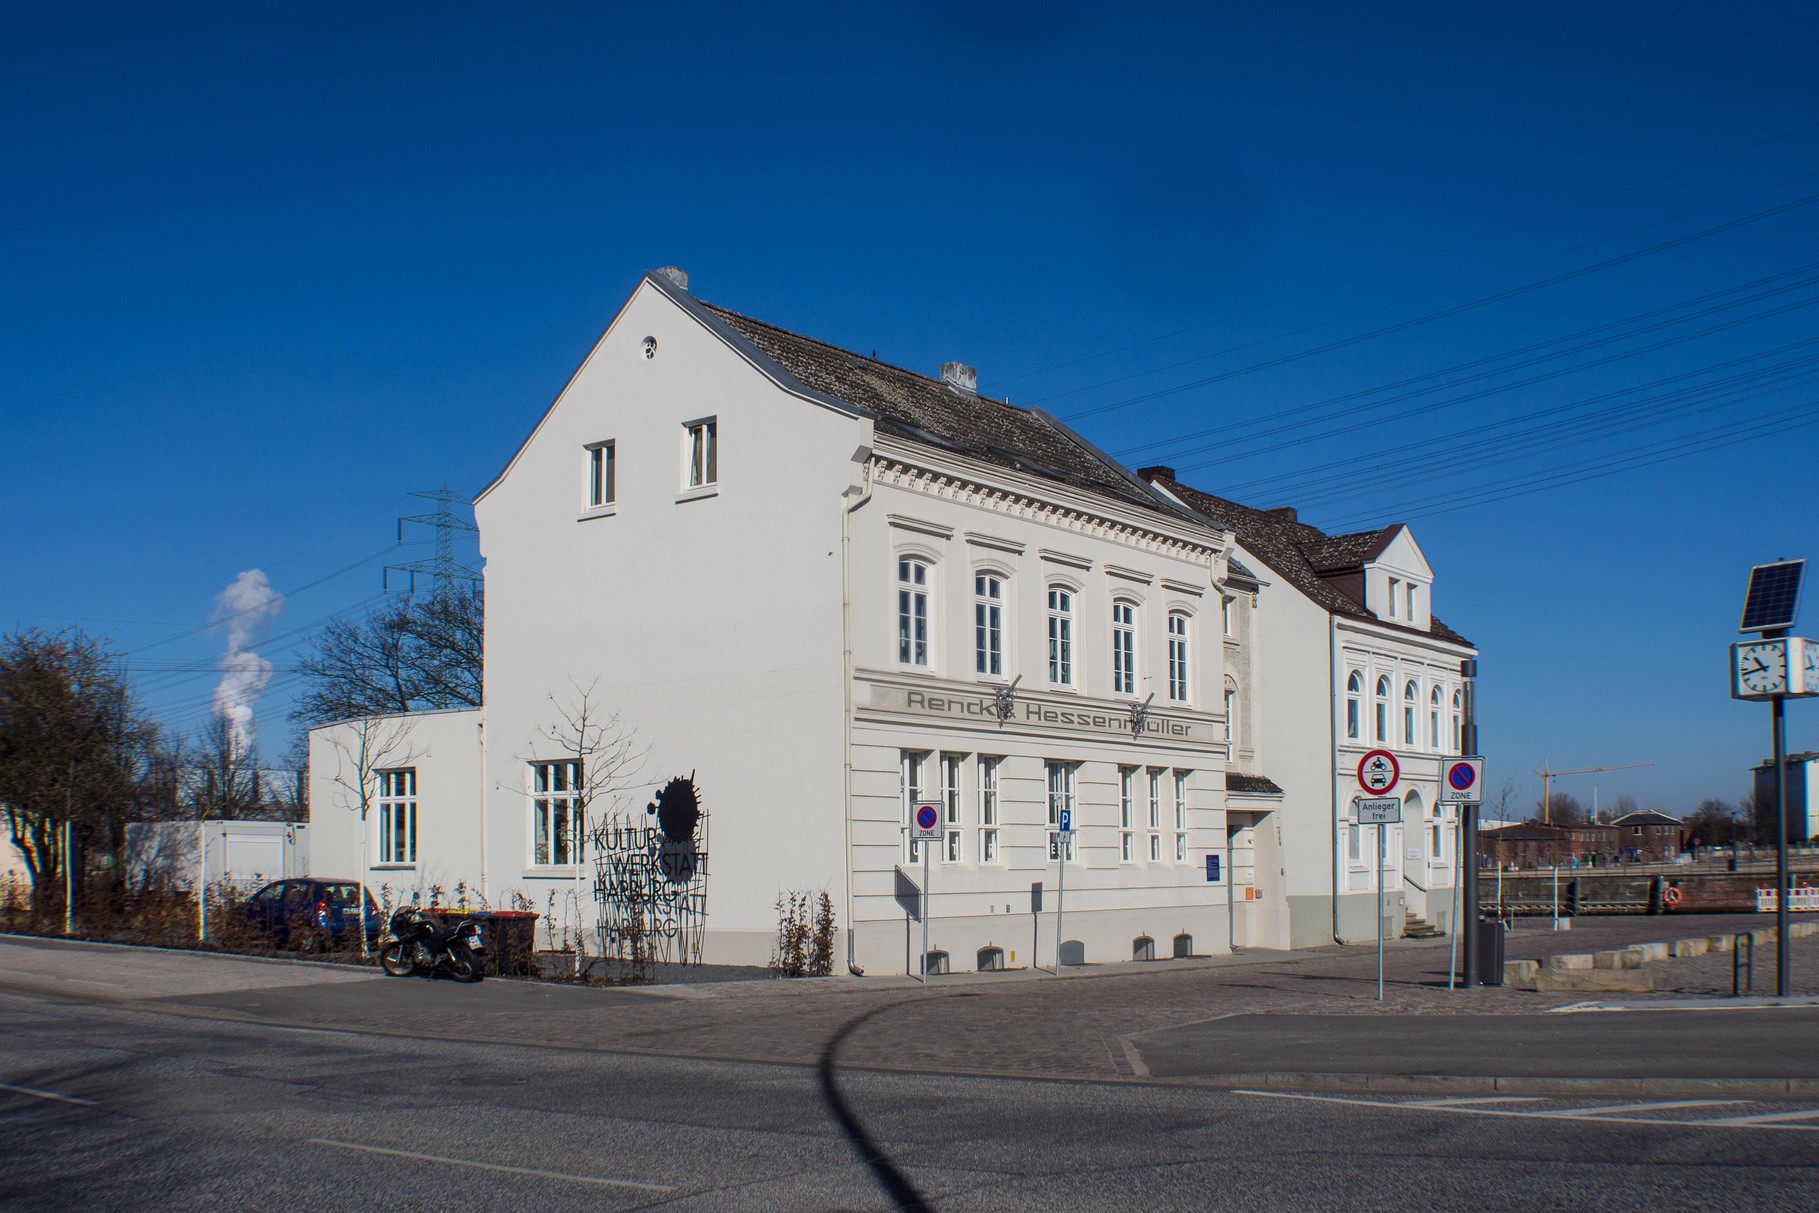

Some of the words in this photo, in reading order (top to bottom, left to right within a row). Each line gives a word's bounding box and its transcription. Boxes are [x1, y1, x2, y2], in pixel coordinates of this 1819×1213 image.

[907, 691, 996, 717] Renck
[1450, 791, 1471, 800] ZONE
[1362, 802, 1395, 811] Anlieger
[1061, 812, 1069, 829] P
[1372, 812, 1386, 820] frei
[594, 828, 657, 851] KULTUR
[918, 829, 935, 837] ZONE
[609, 853, 708, 876] WERKSTATT
[593, 880, 678, 902] HARBURG
